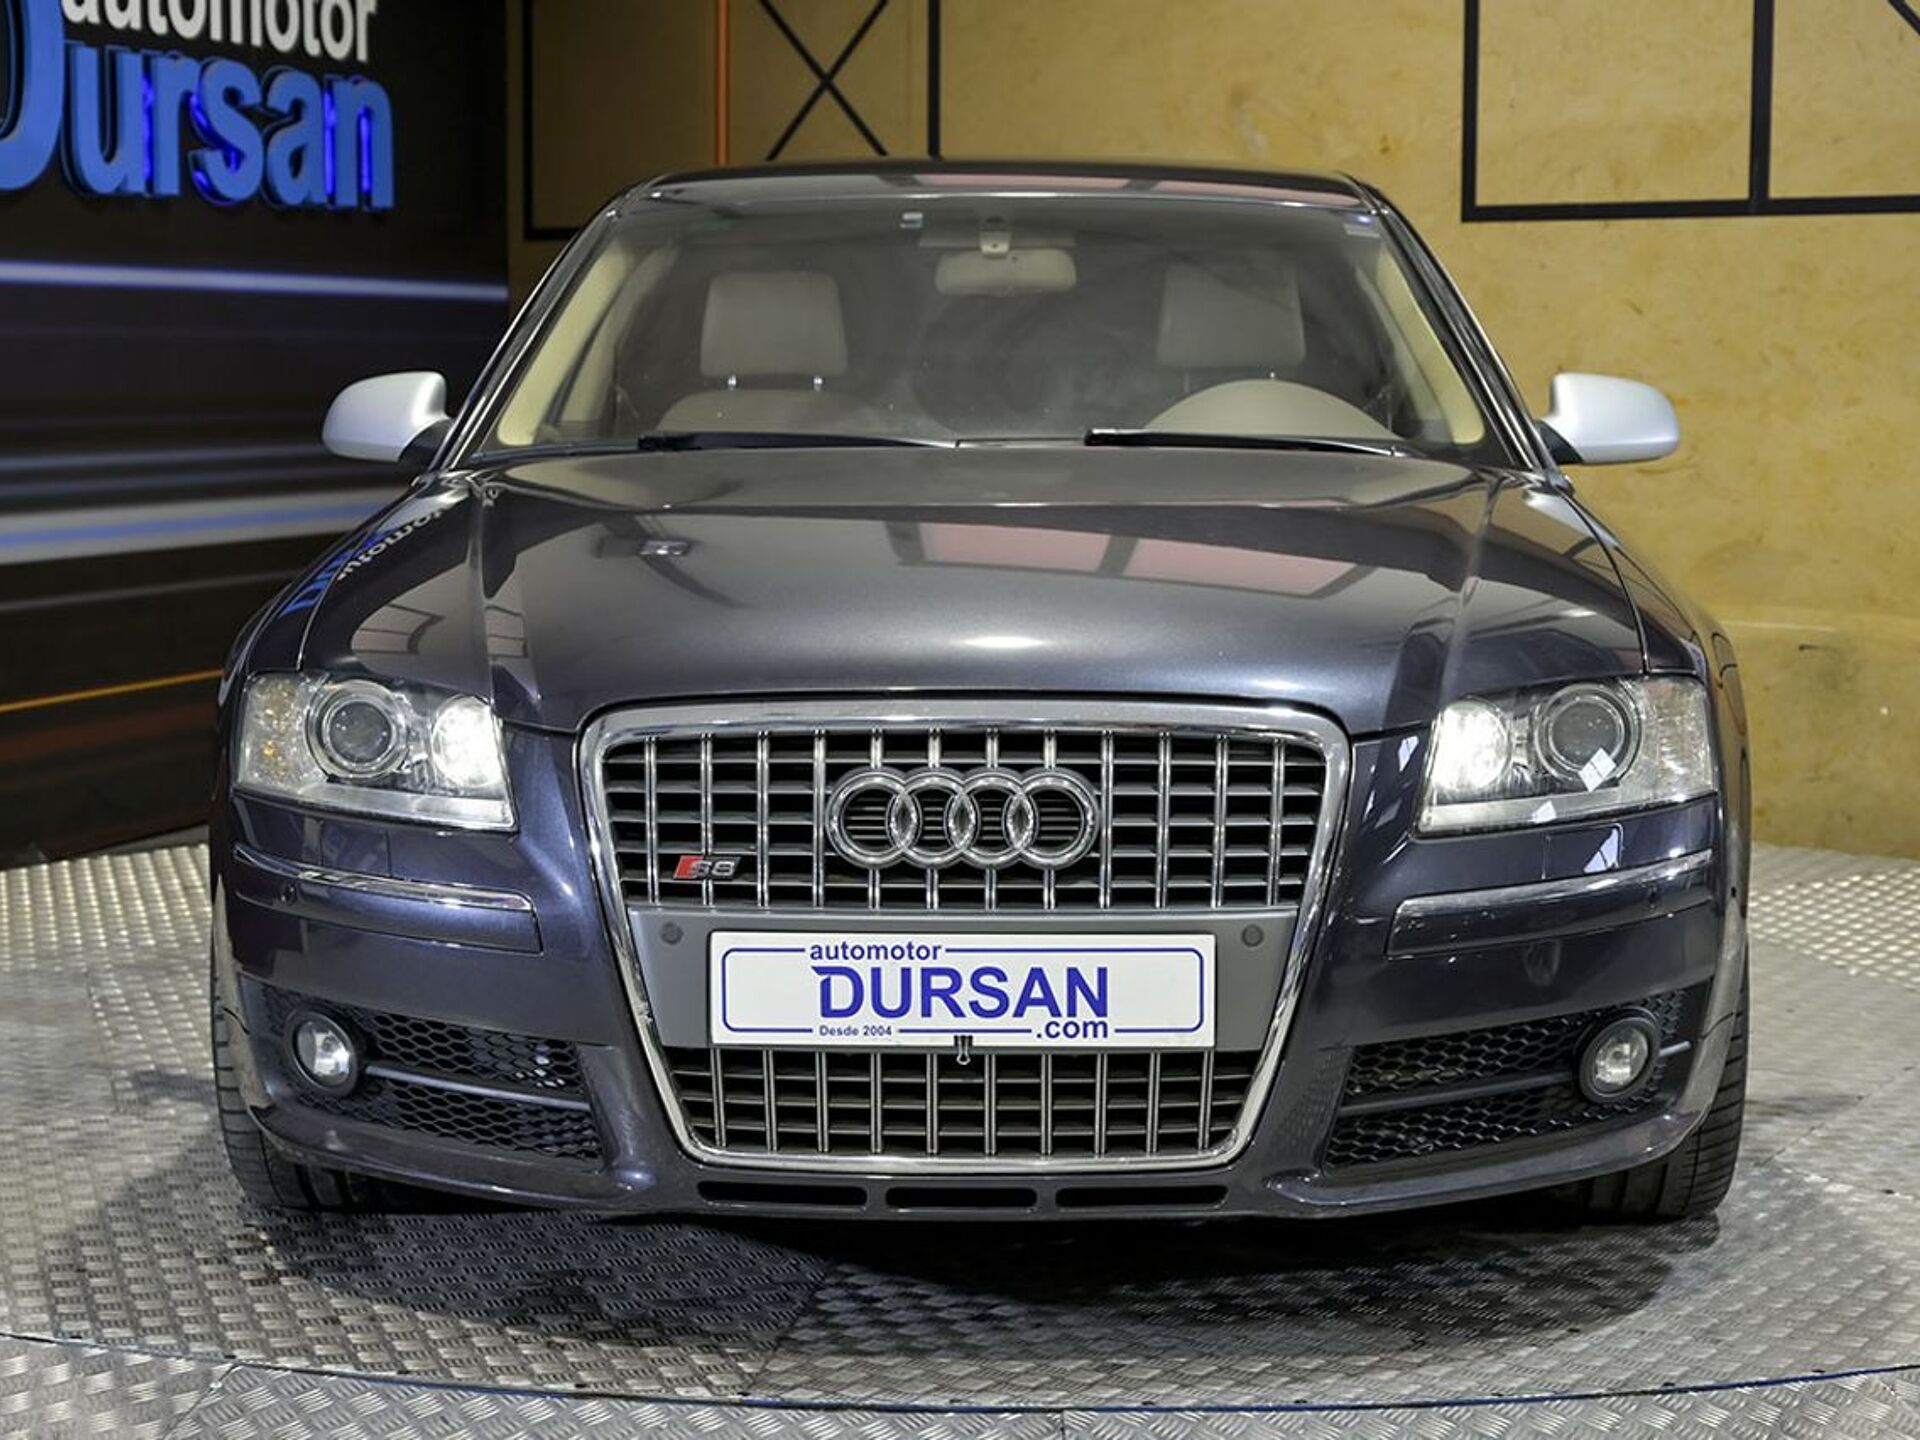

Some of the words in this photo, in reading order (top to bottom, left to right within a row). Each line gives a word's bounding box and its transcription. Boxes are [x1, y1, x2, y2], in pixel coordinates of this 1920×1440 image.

[809, 941, 942, 960] automotor
[811, 966, 1108, 1019] DURSAN
[819, 1024, 859, 1037] Desde
[863, 1025, 892, 1037] 2004
[1036, 1020, 1108, 1039] .com
